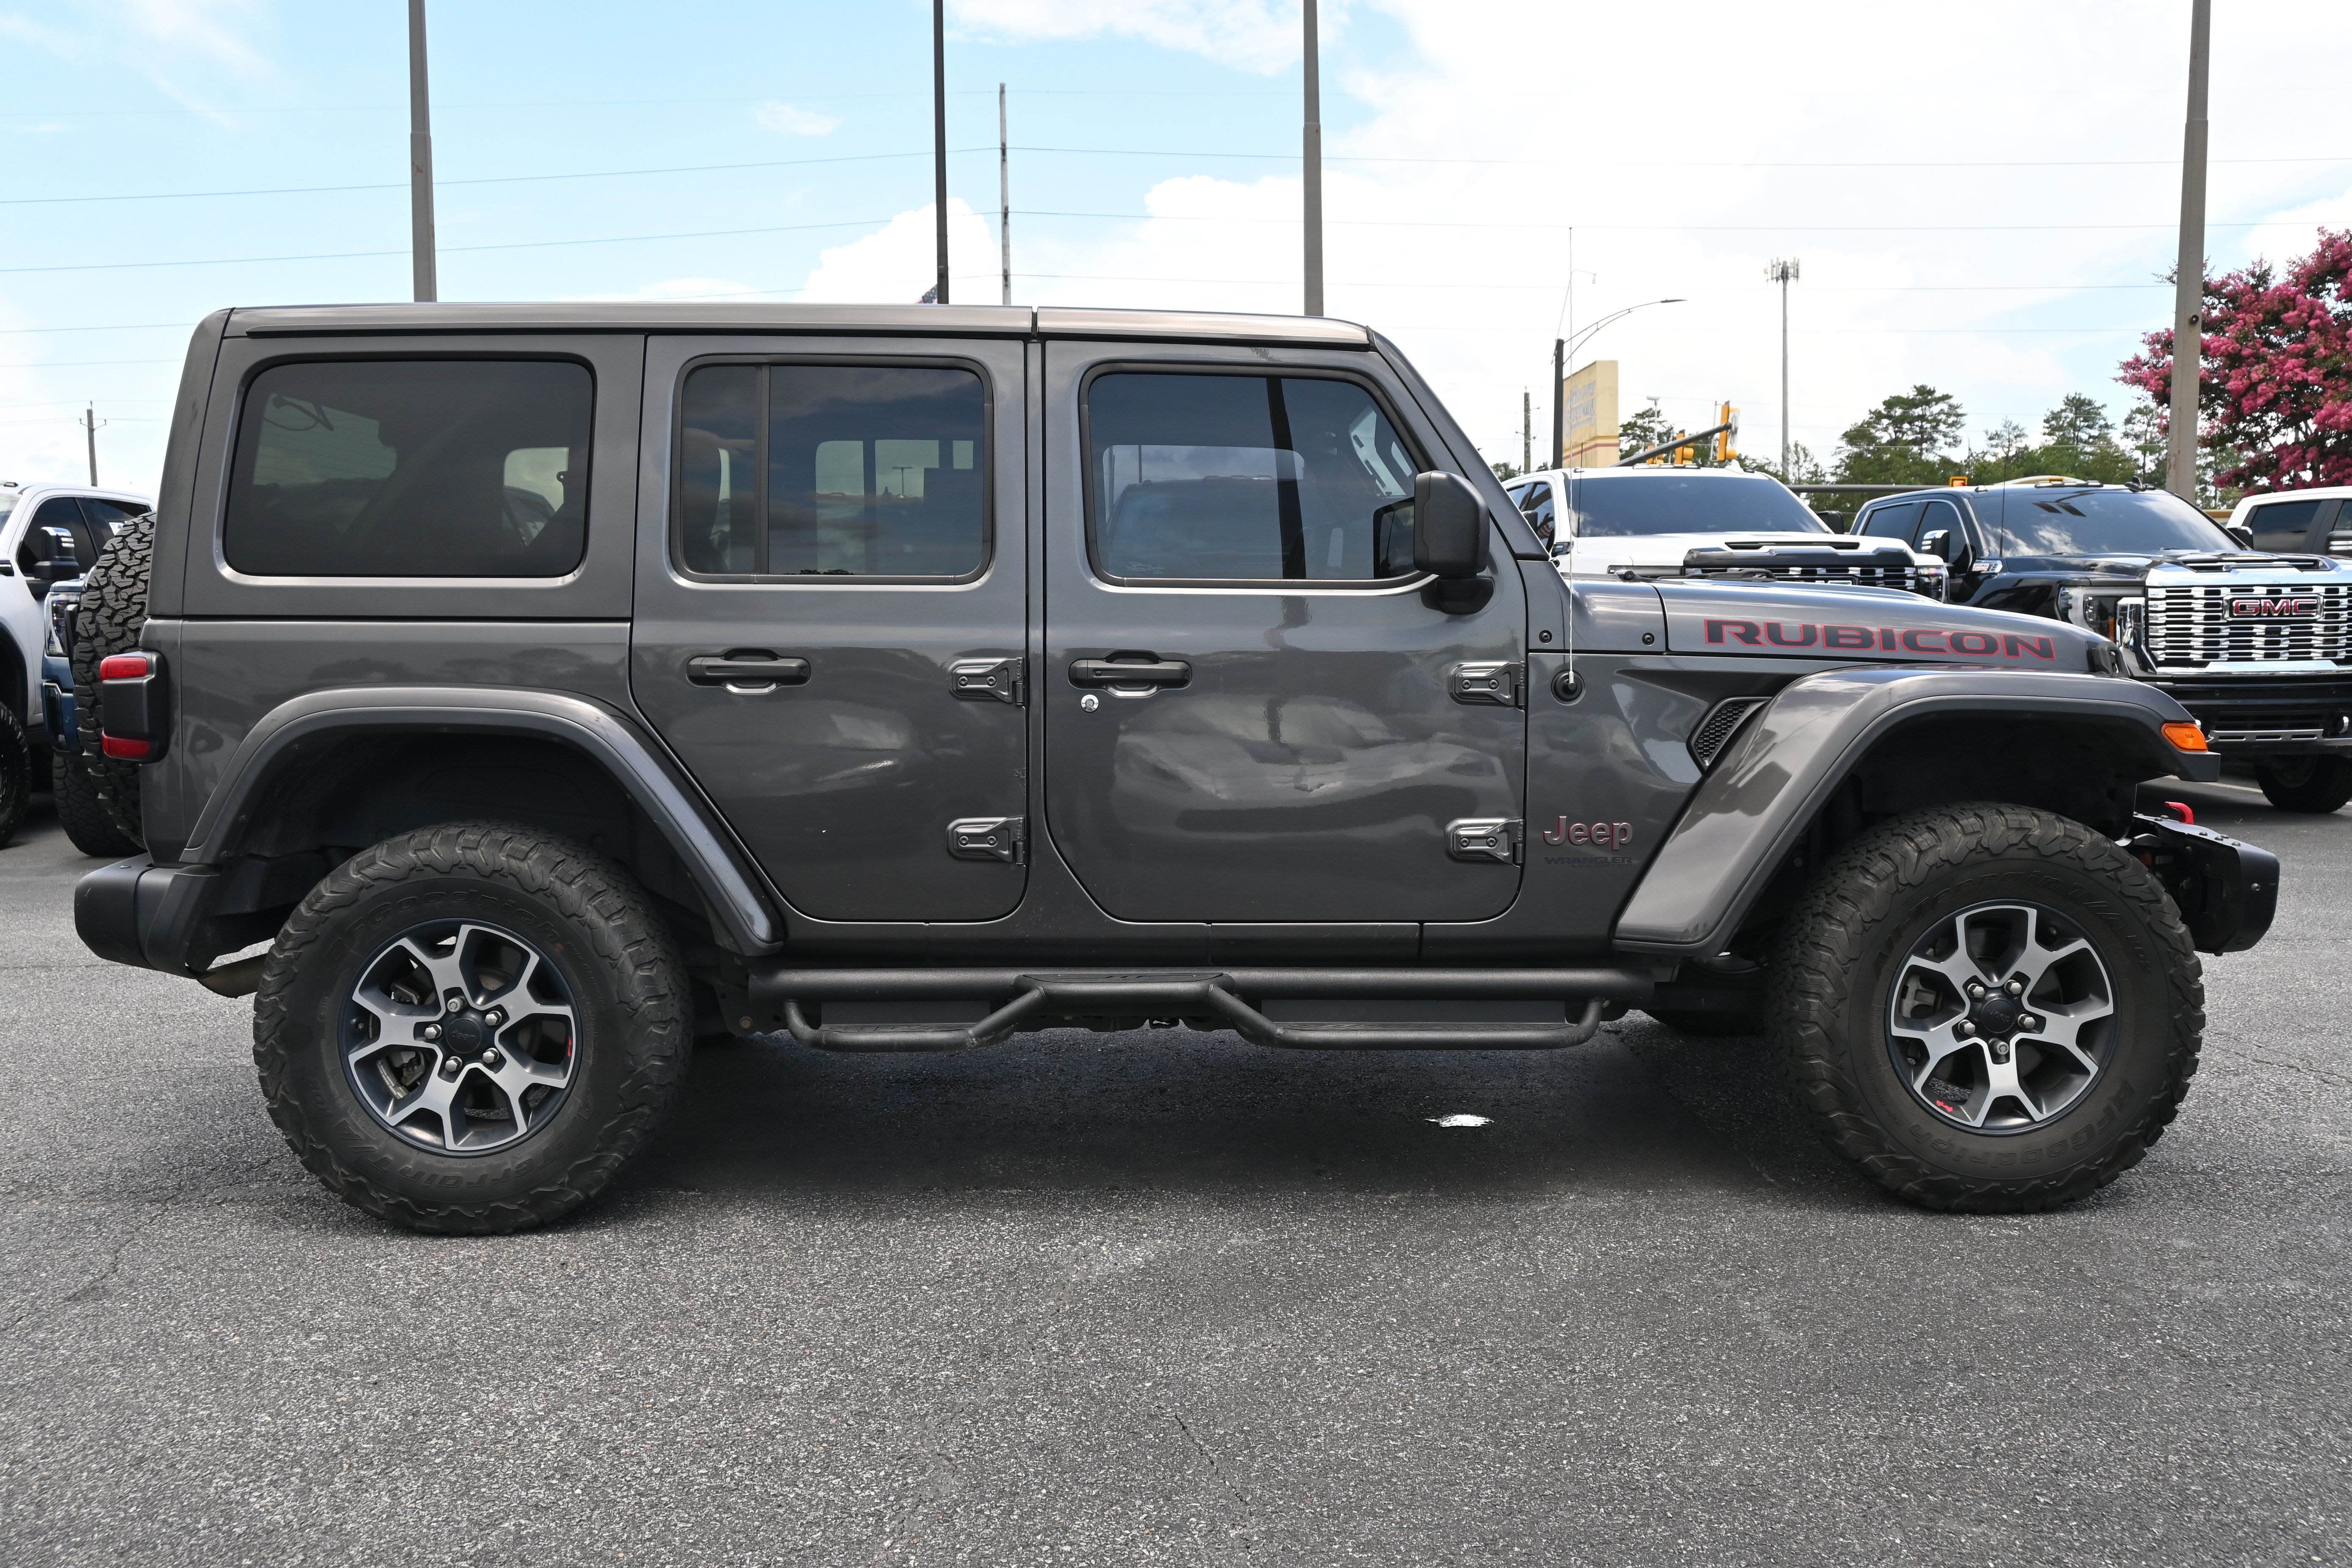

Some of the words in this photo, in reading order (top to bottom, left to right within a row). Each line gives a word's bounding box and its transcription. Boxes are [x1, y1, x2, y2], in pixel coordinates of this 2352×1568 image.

[2232, 599, 2317, 616] GMC
[1704, 619, 2056, 661] RUBICON
[1544, 816, 1633, 851] Jeep
[1544, 856, 1632, 865] WRANGLER
[324, 889, 561, 969] BFGoodrich
[1873, 870, 2061, 975] All-Terrain
[2071, 882, 2127, 933] T/A
[333, 1121, 390, 1172] T/A
[396, 1089, 597, 1190] All-Terrain
[1909, 1080, 2137, 1168] BFGoodrich
